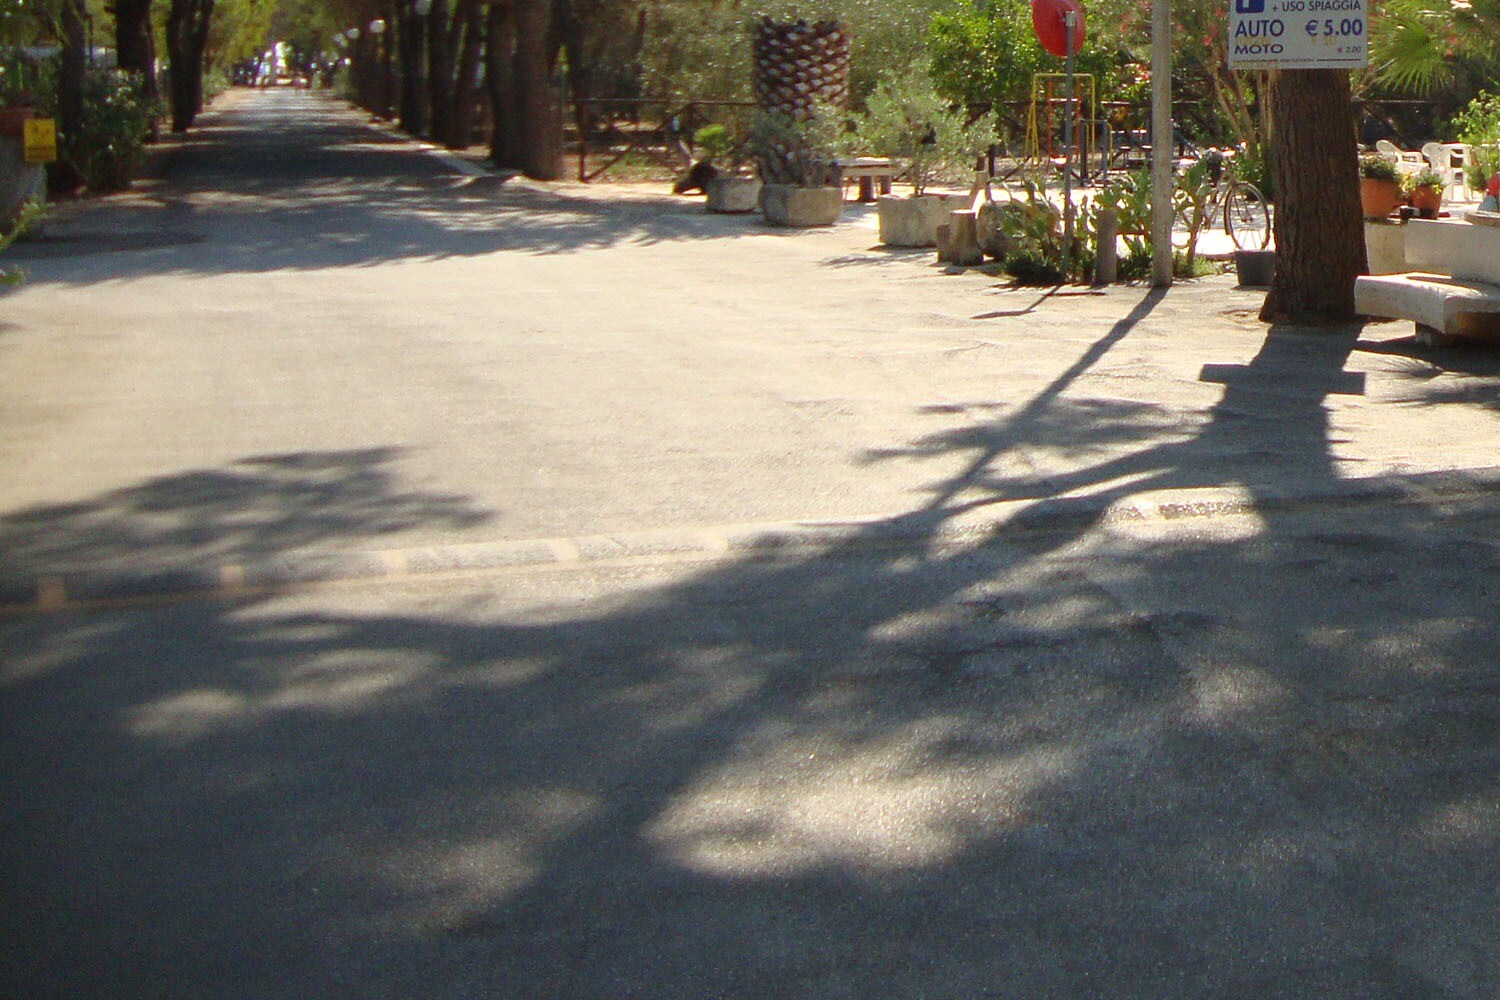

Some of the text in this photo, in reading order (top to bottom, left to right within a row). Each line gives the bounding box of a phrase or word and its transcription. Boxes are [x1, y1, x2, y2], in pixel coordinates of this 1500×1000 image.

[1282, 1, 1305, 12] USO
[1308, 0, 1361, 11] SPIAGGIA
[1235, 19, 1285, 38] AUTO
[1234, 43, 1284, 55] MOTO
